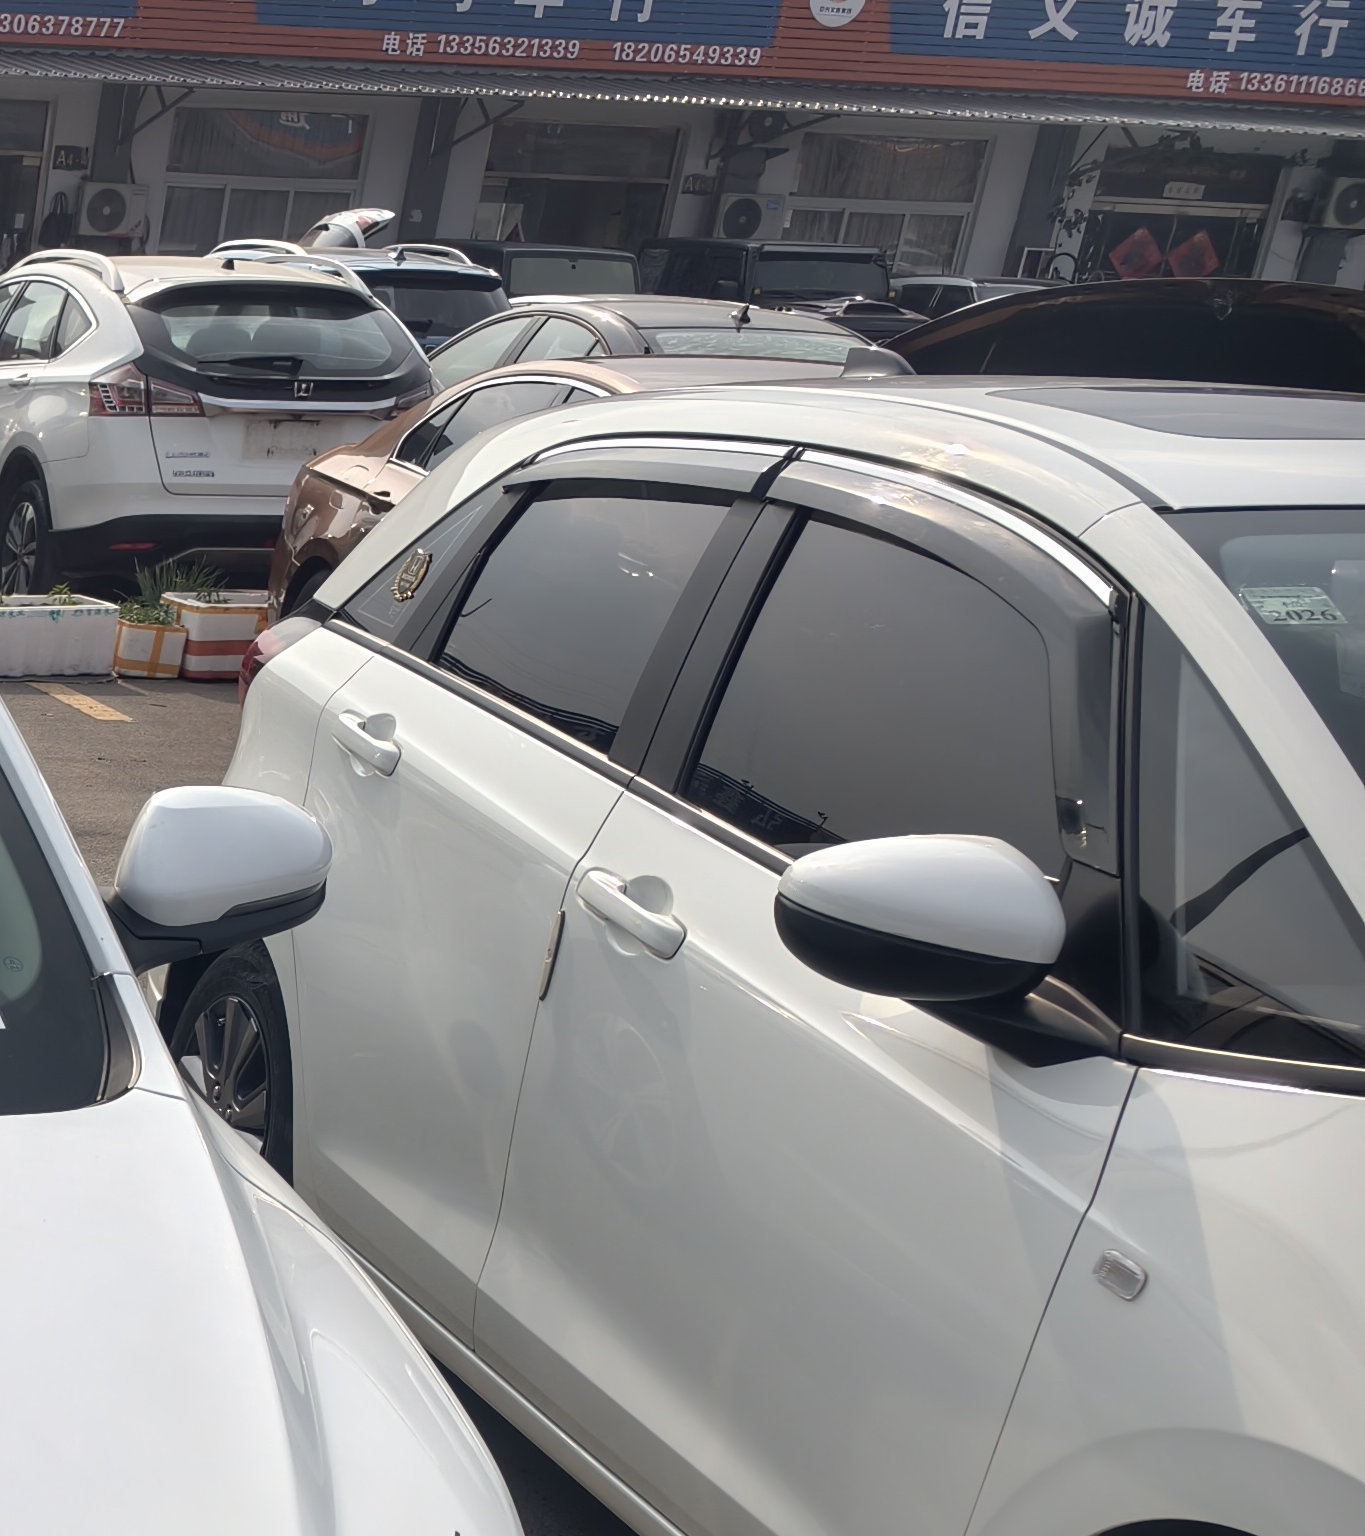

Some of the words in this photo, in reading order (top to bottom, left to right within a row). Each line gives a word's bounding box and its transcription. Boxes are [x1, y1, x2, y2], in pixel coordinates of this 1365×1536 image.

[382, 31, 427, 57] 电话
[437, 34, 580, 60] 13356321339
[612, 42, 761, 67] 18206549339
[1186, 70, 1231, 95] 电话
[1268, 608, 1338, 622] 2026
